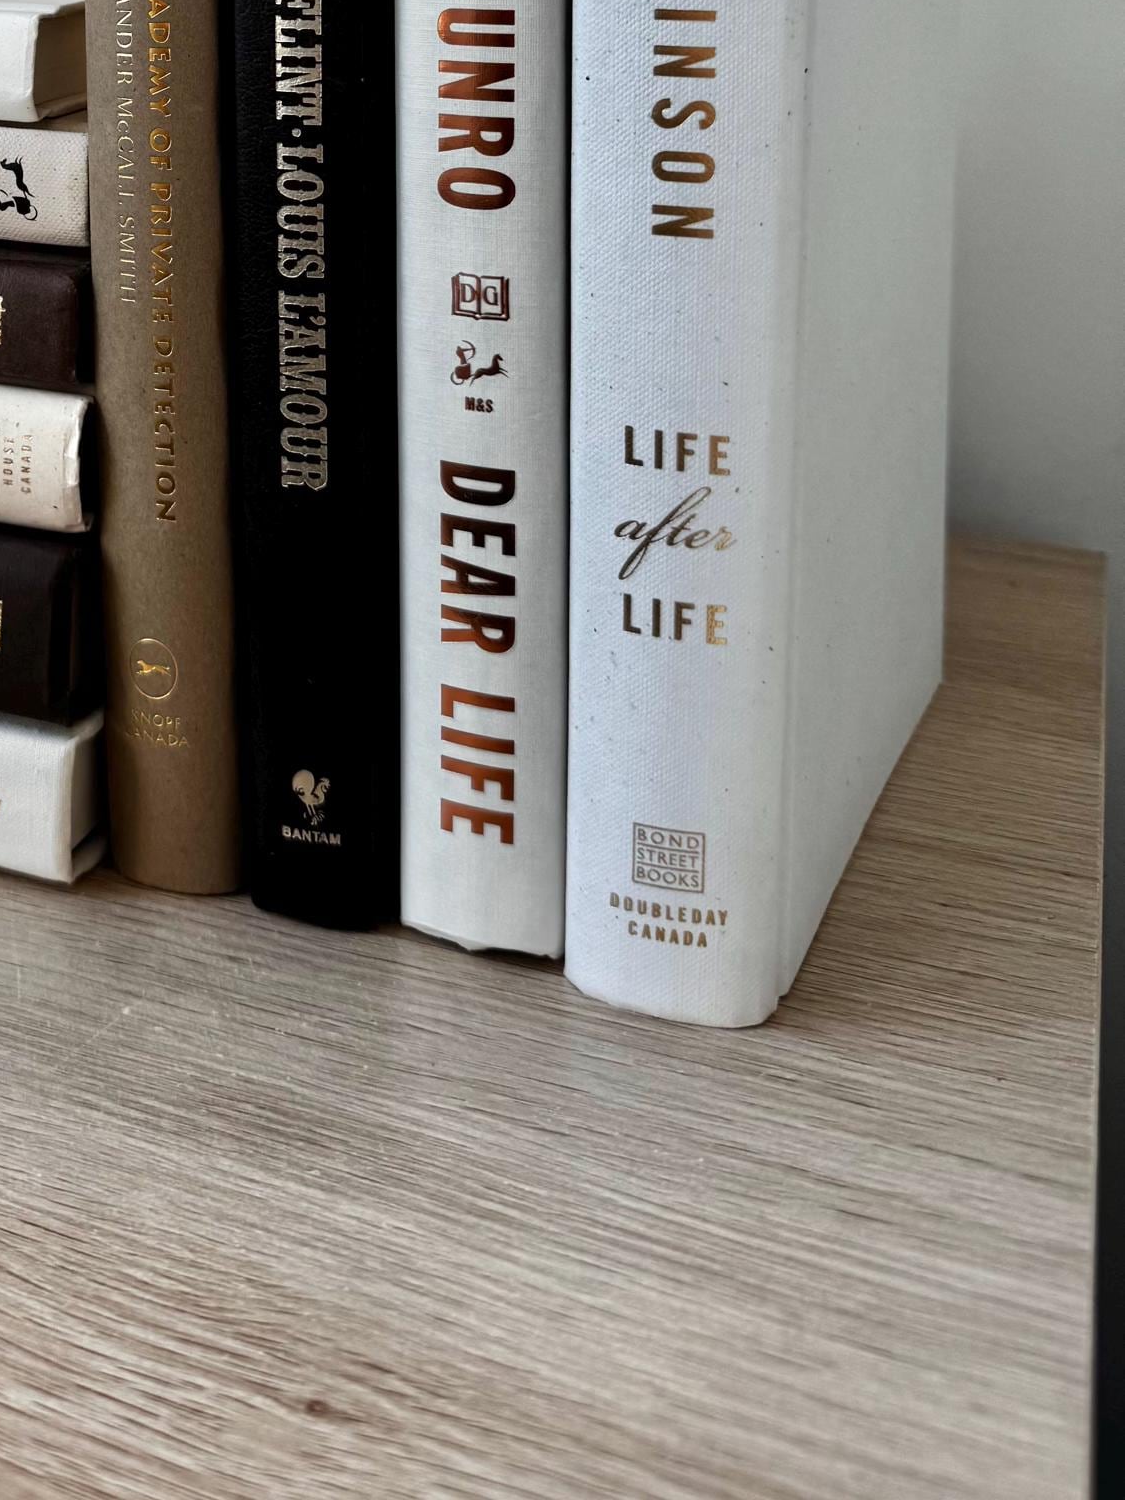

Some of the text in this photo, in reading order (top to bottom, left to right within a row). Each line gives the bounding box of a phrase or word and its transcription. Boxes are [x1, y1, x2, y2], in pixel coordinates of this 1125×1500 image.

[149, 127, 172, 172] OF
[276, 142, 325, 279] LOUIS
[119, 216, 136, 303] SMITH
[150, 182, 174, 324] PRIVATE
[278, 290, 328, 491] L'AMOUR
[465, 396, 493, 413] M&S
[152, 337, 177, 523] DETECTION
[624, 425, 731, 476] LIFE
[3, 437, 14, 485] HOUSE
[20, 434, 33, 494] CANADA
[613, 486, 737, 580] after
[622, 593, 728, 646] LIFE
[439, 459, 516, 845] DEAR LIFE
[281, 825, 341, 846] BANTAM
[637, 828, 700, 849] BOND
[637, 848, 699, 868] STREET
[636, 866, 699, 888] BOOKS
[609, 892, 728, 926] DOUBLEDAY
[628, 920, 708, 948] CANADA
